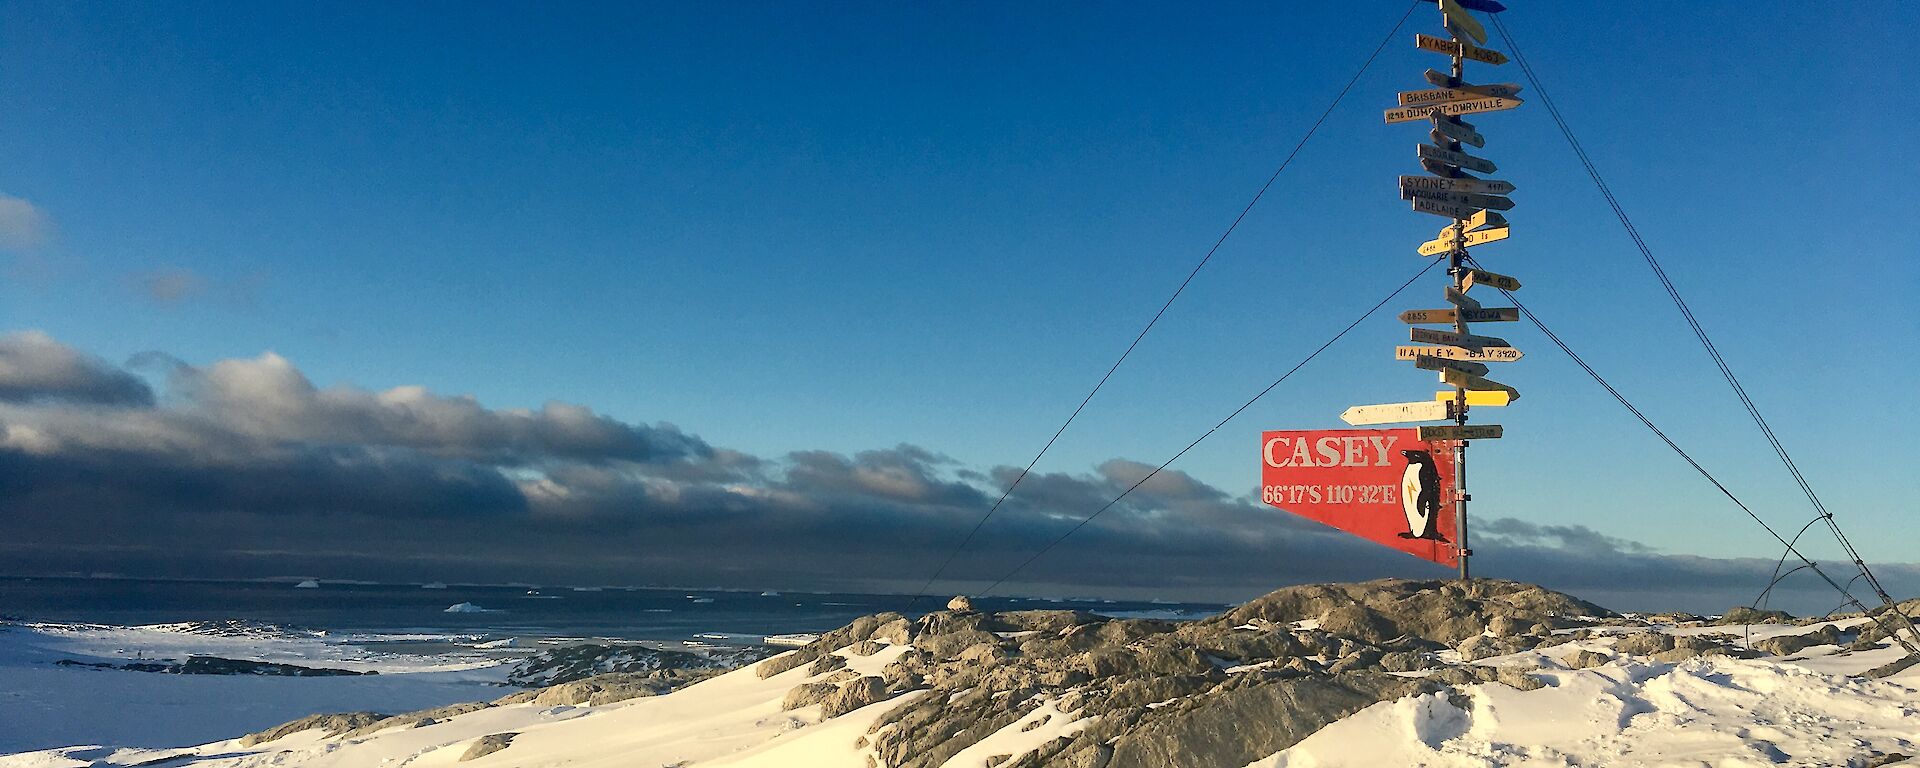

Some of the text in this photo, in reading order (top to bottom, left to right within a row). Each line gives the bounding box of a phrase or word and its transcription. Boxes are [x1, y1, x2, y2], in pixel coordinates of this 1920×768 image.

[1407, 90, 1455, 103] BRISBANE
[1407, 178, 1453, 190] SYDNEY
[1419, 201, 1460, 216] ADELAIDE
[1469, 349, 1494, 358] BAY
[1496, 350, 1517, 358] 3920
[1263, 436, 1398, 468] CASEY
[1263, 484, 1397, 504] 66°17'S 110°32'E
